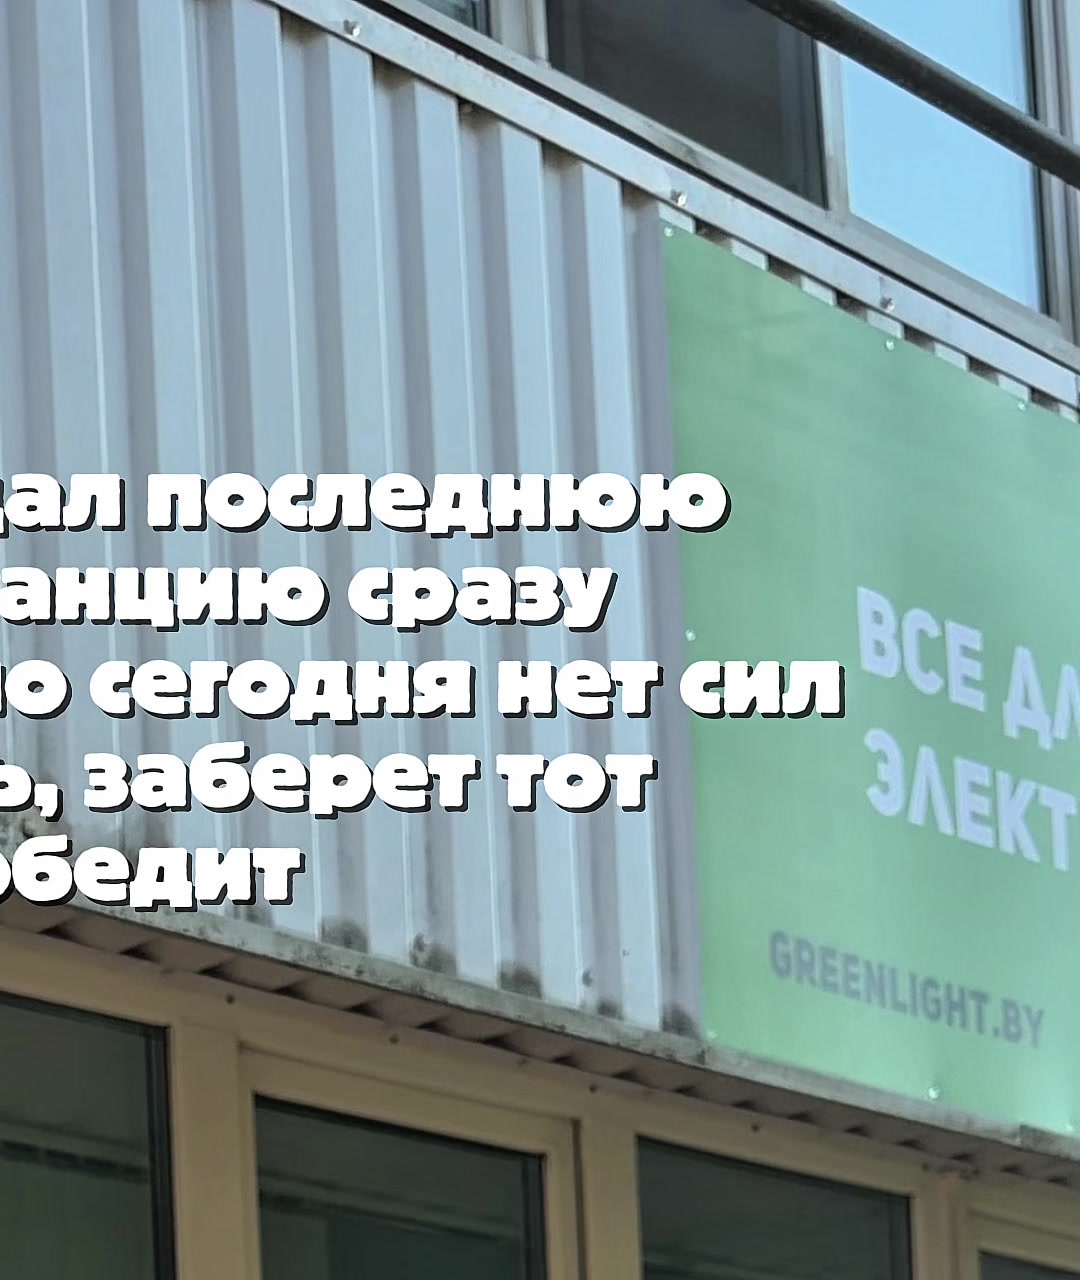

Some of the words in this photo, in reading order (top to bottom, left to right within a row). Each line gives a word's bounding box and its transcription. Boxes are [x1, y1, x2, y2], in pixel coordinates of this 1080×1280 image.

[857, 586, 986, 712] ВСЕ
[864, 728, 1077, 872] ЭЛЕКТ
[769, 930, 1046, 1048] GREENLIGHT.BY
